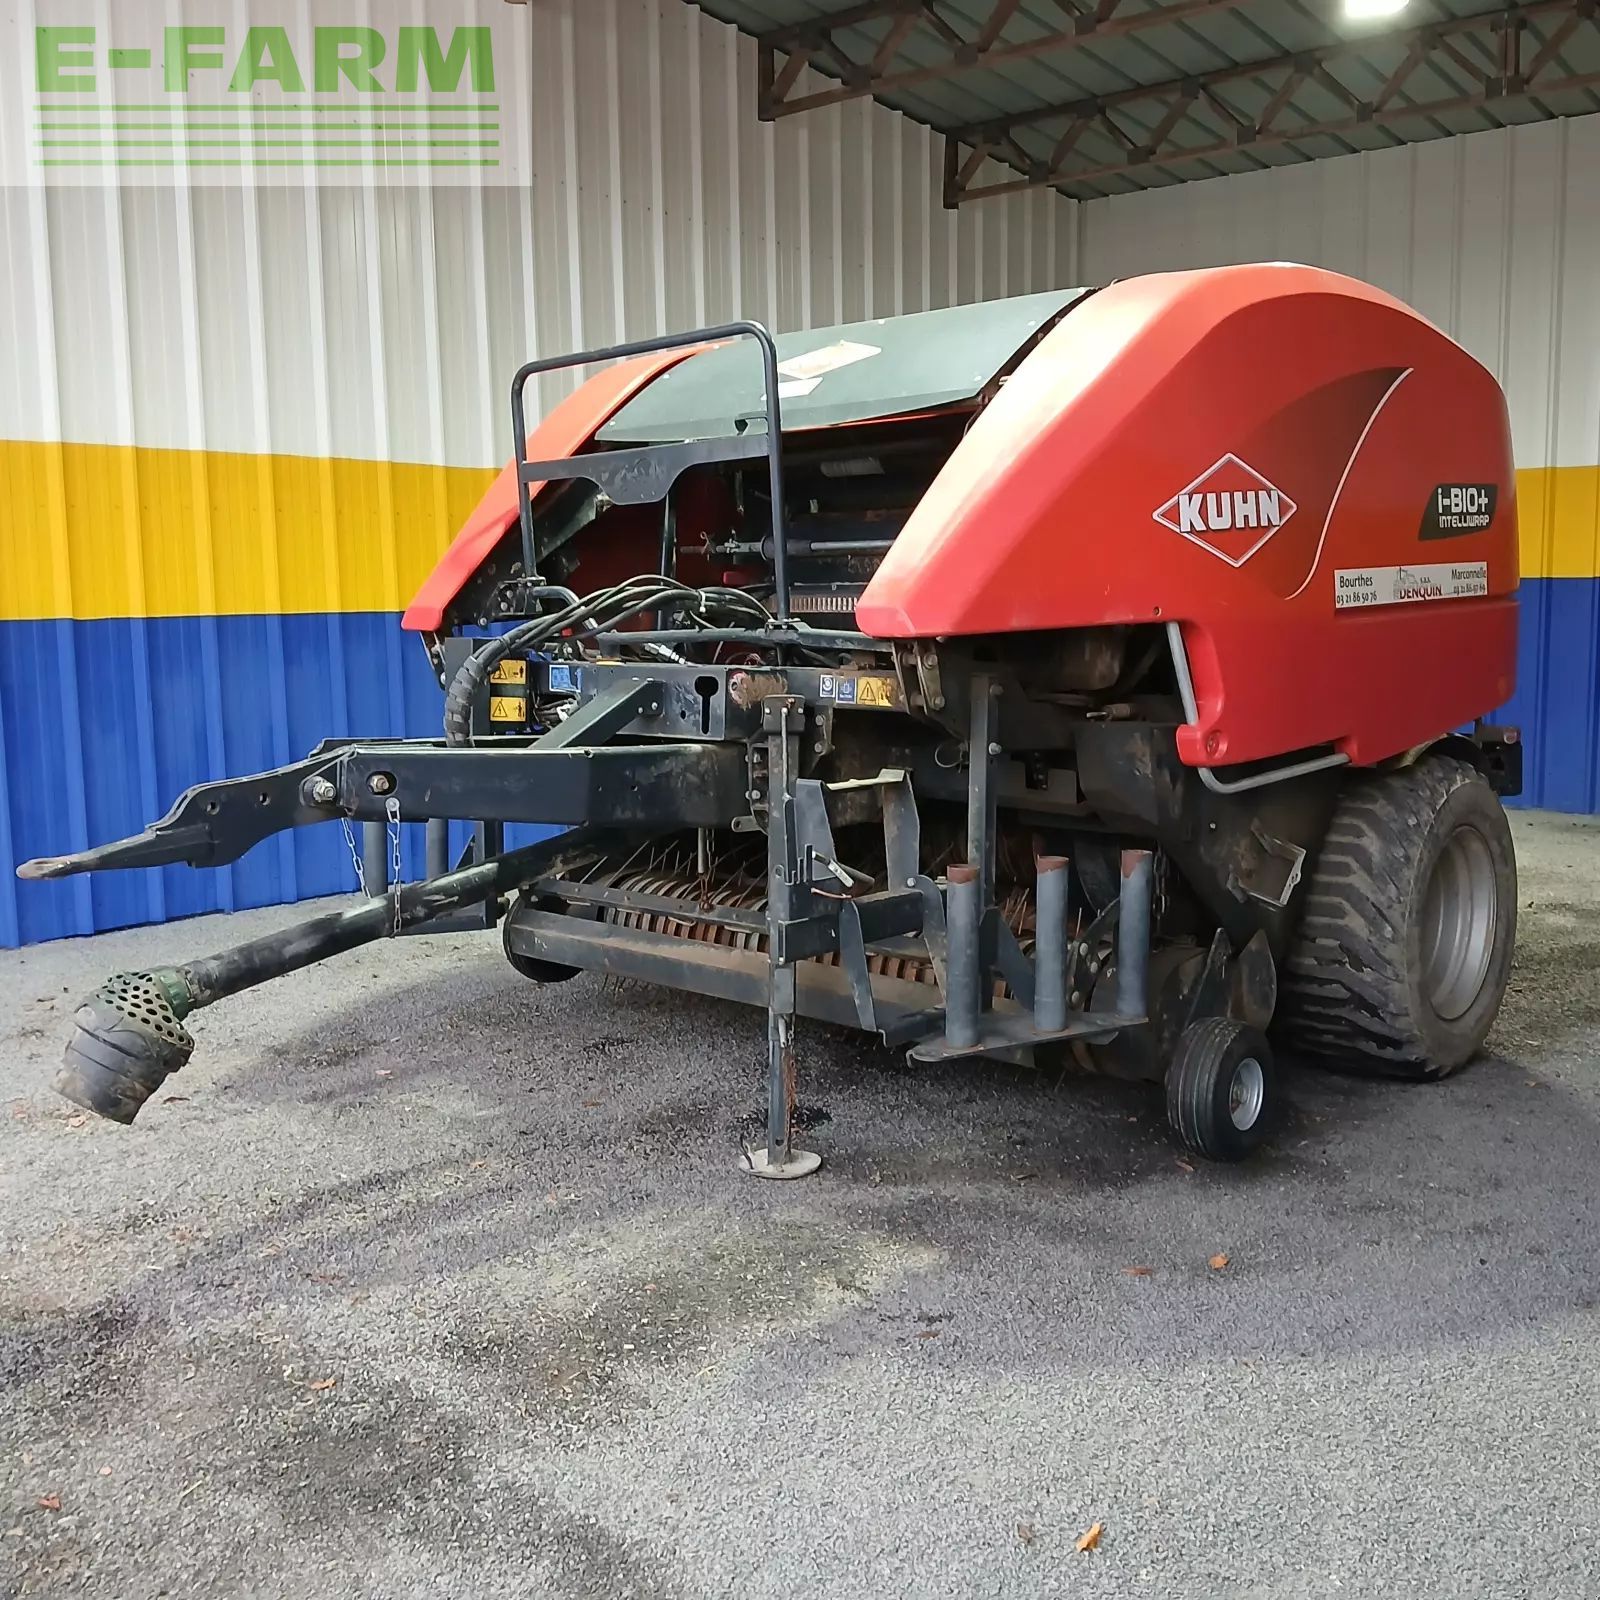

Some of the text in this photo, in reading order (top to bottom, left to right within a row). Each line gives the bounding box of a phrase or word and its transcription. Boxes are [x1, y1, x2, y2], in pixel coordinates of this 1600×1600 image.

[1178, 490, 1281, 533] KUHN
[1339, 573, 1373, 588] Bourthes
[1400, 584, 1443, 600] DENQUIN
